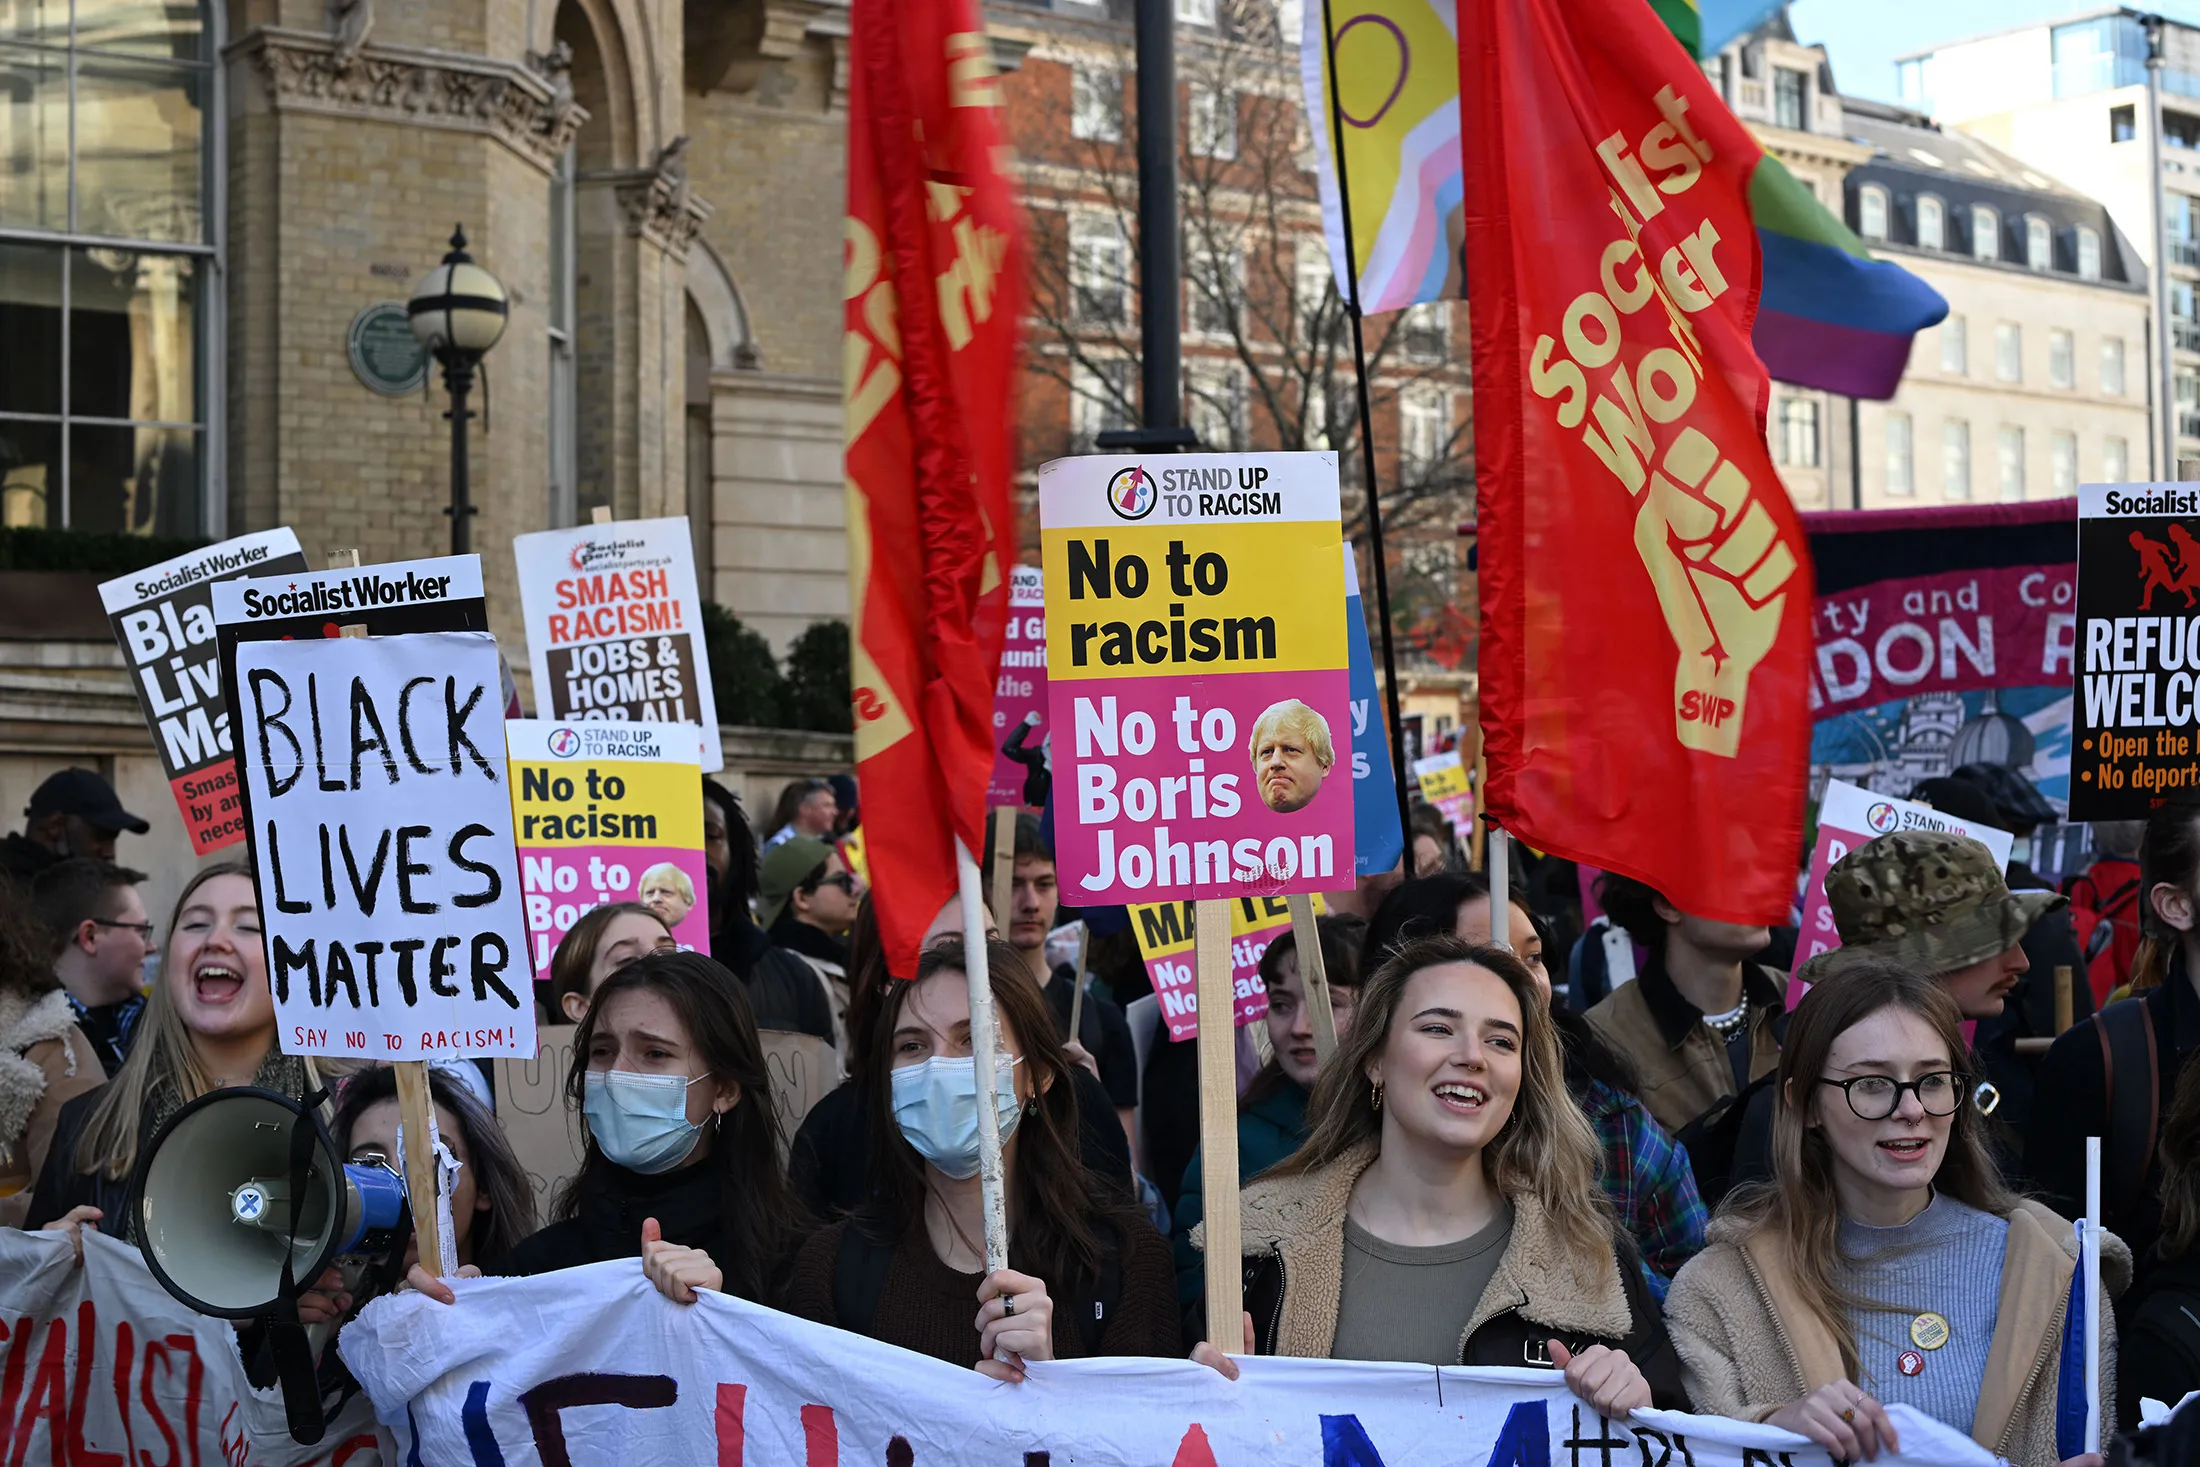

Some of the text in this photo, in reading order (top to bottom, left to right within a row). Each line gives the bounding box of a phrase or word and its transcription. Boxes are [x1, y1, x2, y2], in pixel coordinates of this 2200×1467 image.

[1163, 467, 1268, 492] STAND UP
[1163, 492, 1281, 517] TO RACISM
[556, 569, 668, 609] SMASH
[1067, 539, 1228, 601] No to
[1903, 580, 1980, 616] and
[548, 600, 683, 644] RACISM!
[1070, 603, 1277, 666] racism
[565, 637, 680, 679] JOBS &
[568, 668, 683, 710] HOMES
[2083, 671, 2200, 728] WELC
[1074, 696, 1237, 758] No to
[1679, 689, 1735, 728] SWP
[247, 668, 499, 798] BLACK
[584, 729, 653, 744] STAND UP
[584, 744, 661, 758] TO RACISM
[2099, 729, 2189, 763] Open the
[522, 767, 626, 802] No to
[1077, 758, 1241, 825] Boris
[2098, 761, 2200, 794] No deport
[190, 803, 214, 823] by
[523, 804, 657, 840] racism
[1904, 811, 1945, 832] STAND
[268, 819, 502, 917] LIVES
[523, 856, 631, 893] No to
[1079, 826, 1334, 891] Johnson
[272, 932, 520, 1009] MATTER
[1154, 960, 1192, 989] No
[294, 1026, 516, 1051] SAY NO TO RACISM!
